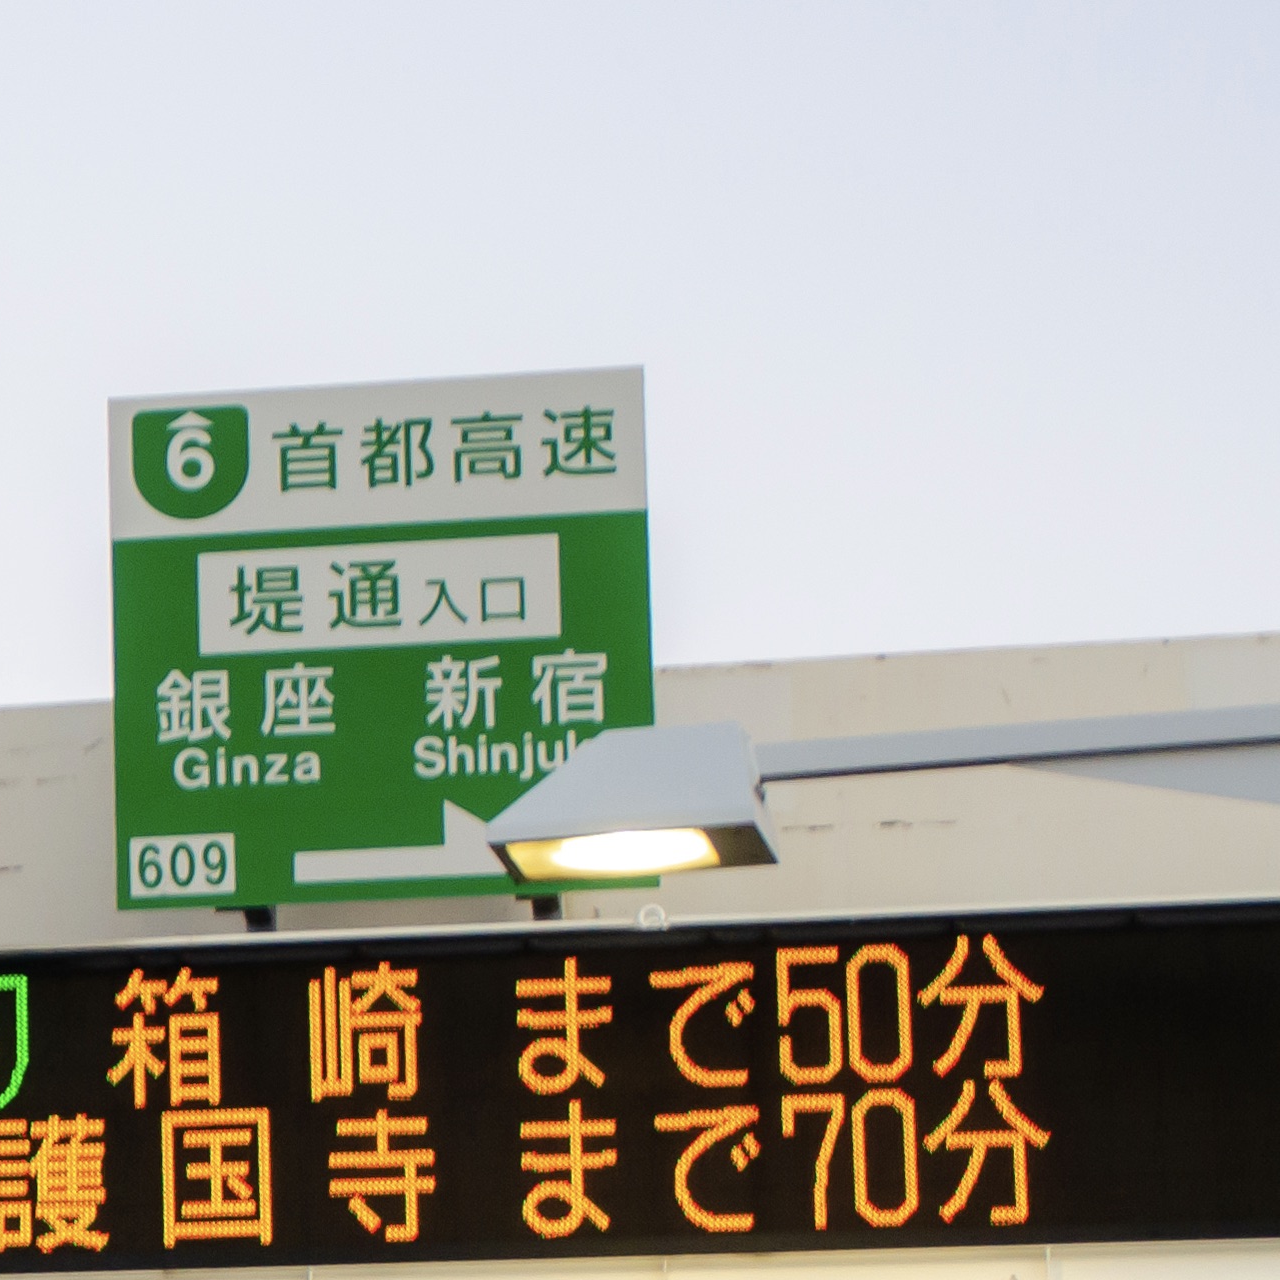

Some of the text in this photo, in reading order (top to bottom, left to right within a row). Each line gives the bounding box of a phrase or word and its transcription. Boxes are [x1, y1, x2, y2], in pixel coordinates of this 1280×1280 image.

[166, 432, 216, 493] 6
[271, 405, 618, 493] 首都高速
[155, 662, 338, 745] 銀座
[424, 648, 609, 731] 新宿
[172, 745, 322, 791] Ginza
[413, 729, 593, 782] Shinju
[137, 841, 229, 889] 609
